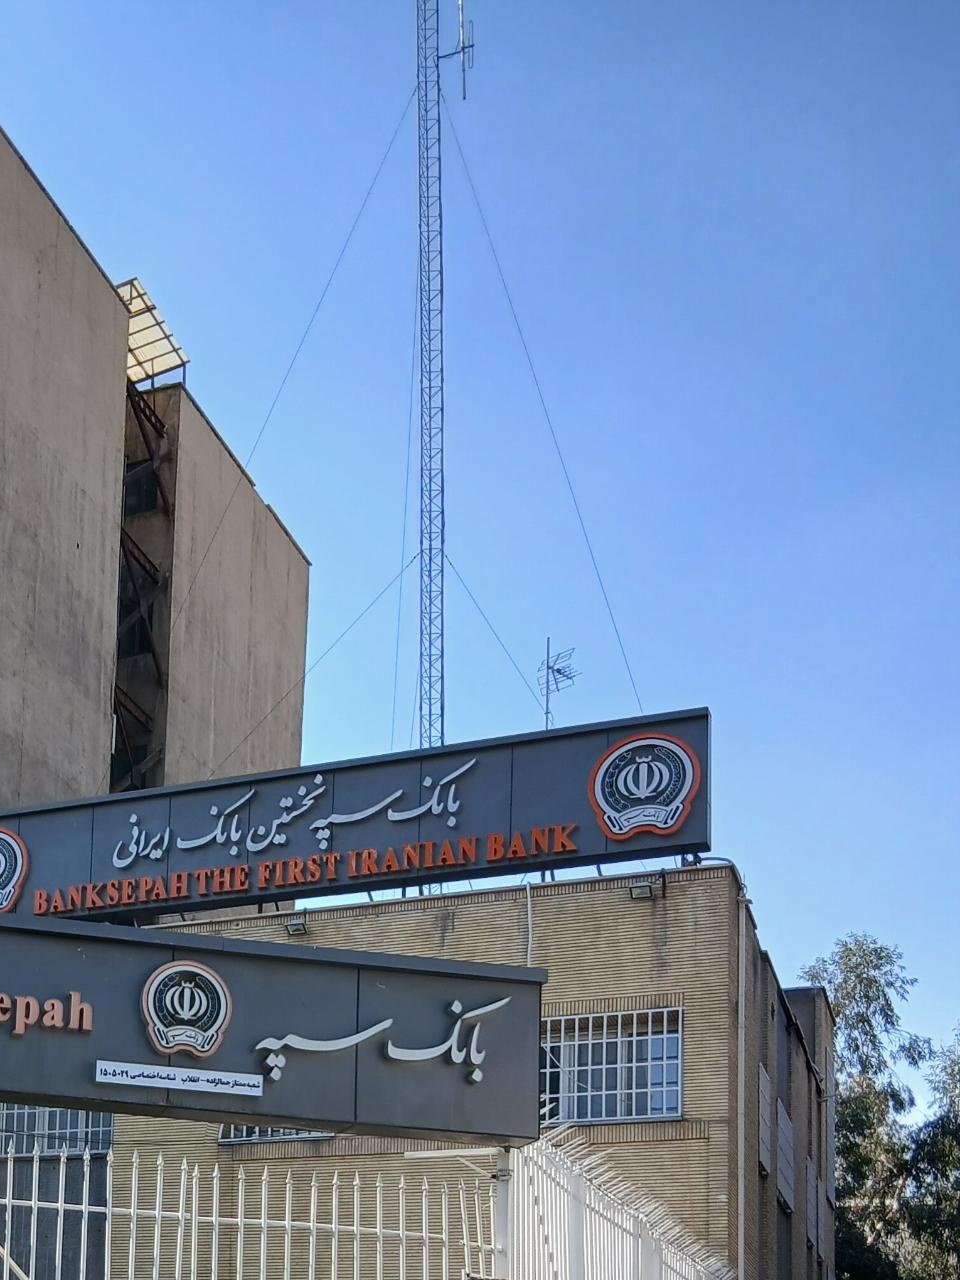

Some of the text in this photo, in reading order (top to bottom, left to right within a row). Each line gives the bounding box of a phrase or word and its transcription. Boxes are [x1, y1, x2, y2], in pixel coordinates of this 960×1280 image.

[113, 758, 477, 869] بانک سپه نخستین بانک ایرانی
[258, 850, 340, 889] FIRST
[347, 837, 477, 878] IRANIAN
[487, 823, 579, 862] BANK
[255, 996, 513, 1084] بانک سپه
